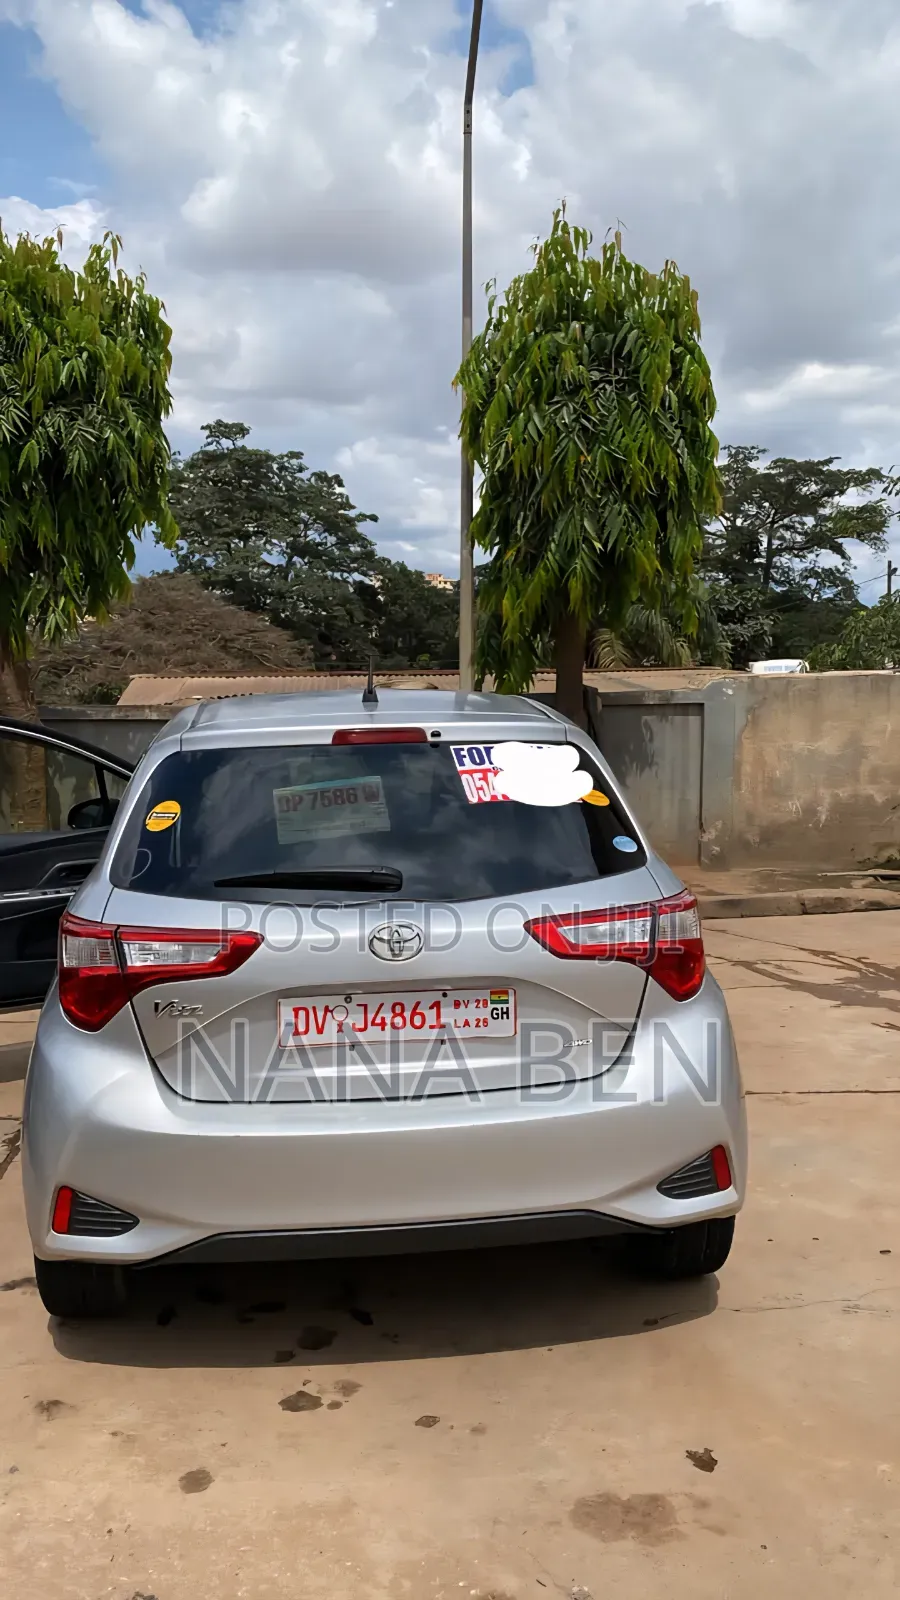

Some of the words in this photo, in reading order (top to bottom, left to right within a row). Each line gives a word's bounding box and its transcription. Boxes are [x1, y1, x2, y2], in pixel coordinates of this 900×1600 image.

[292, 1005, 330, 1036] DV
[351, 1000, 447, 1033] J4861
[490, 1007, 510, 1021] GH
[453, 1018, 471, 1029] LA
